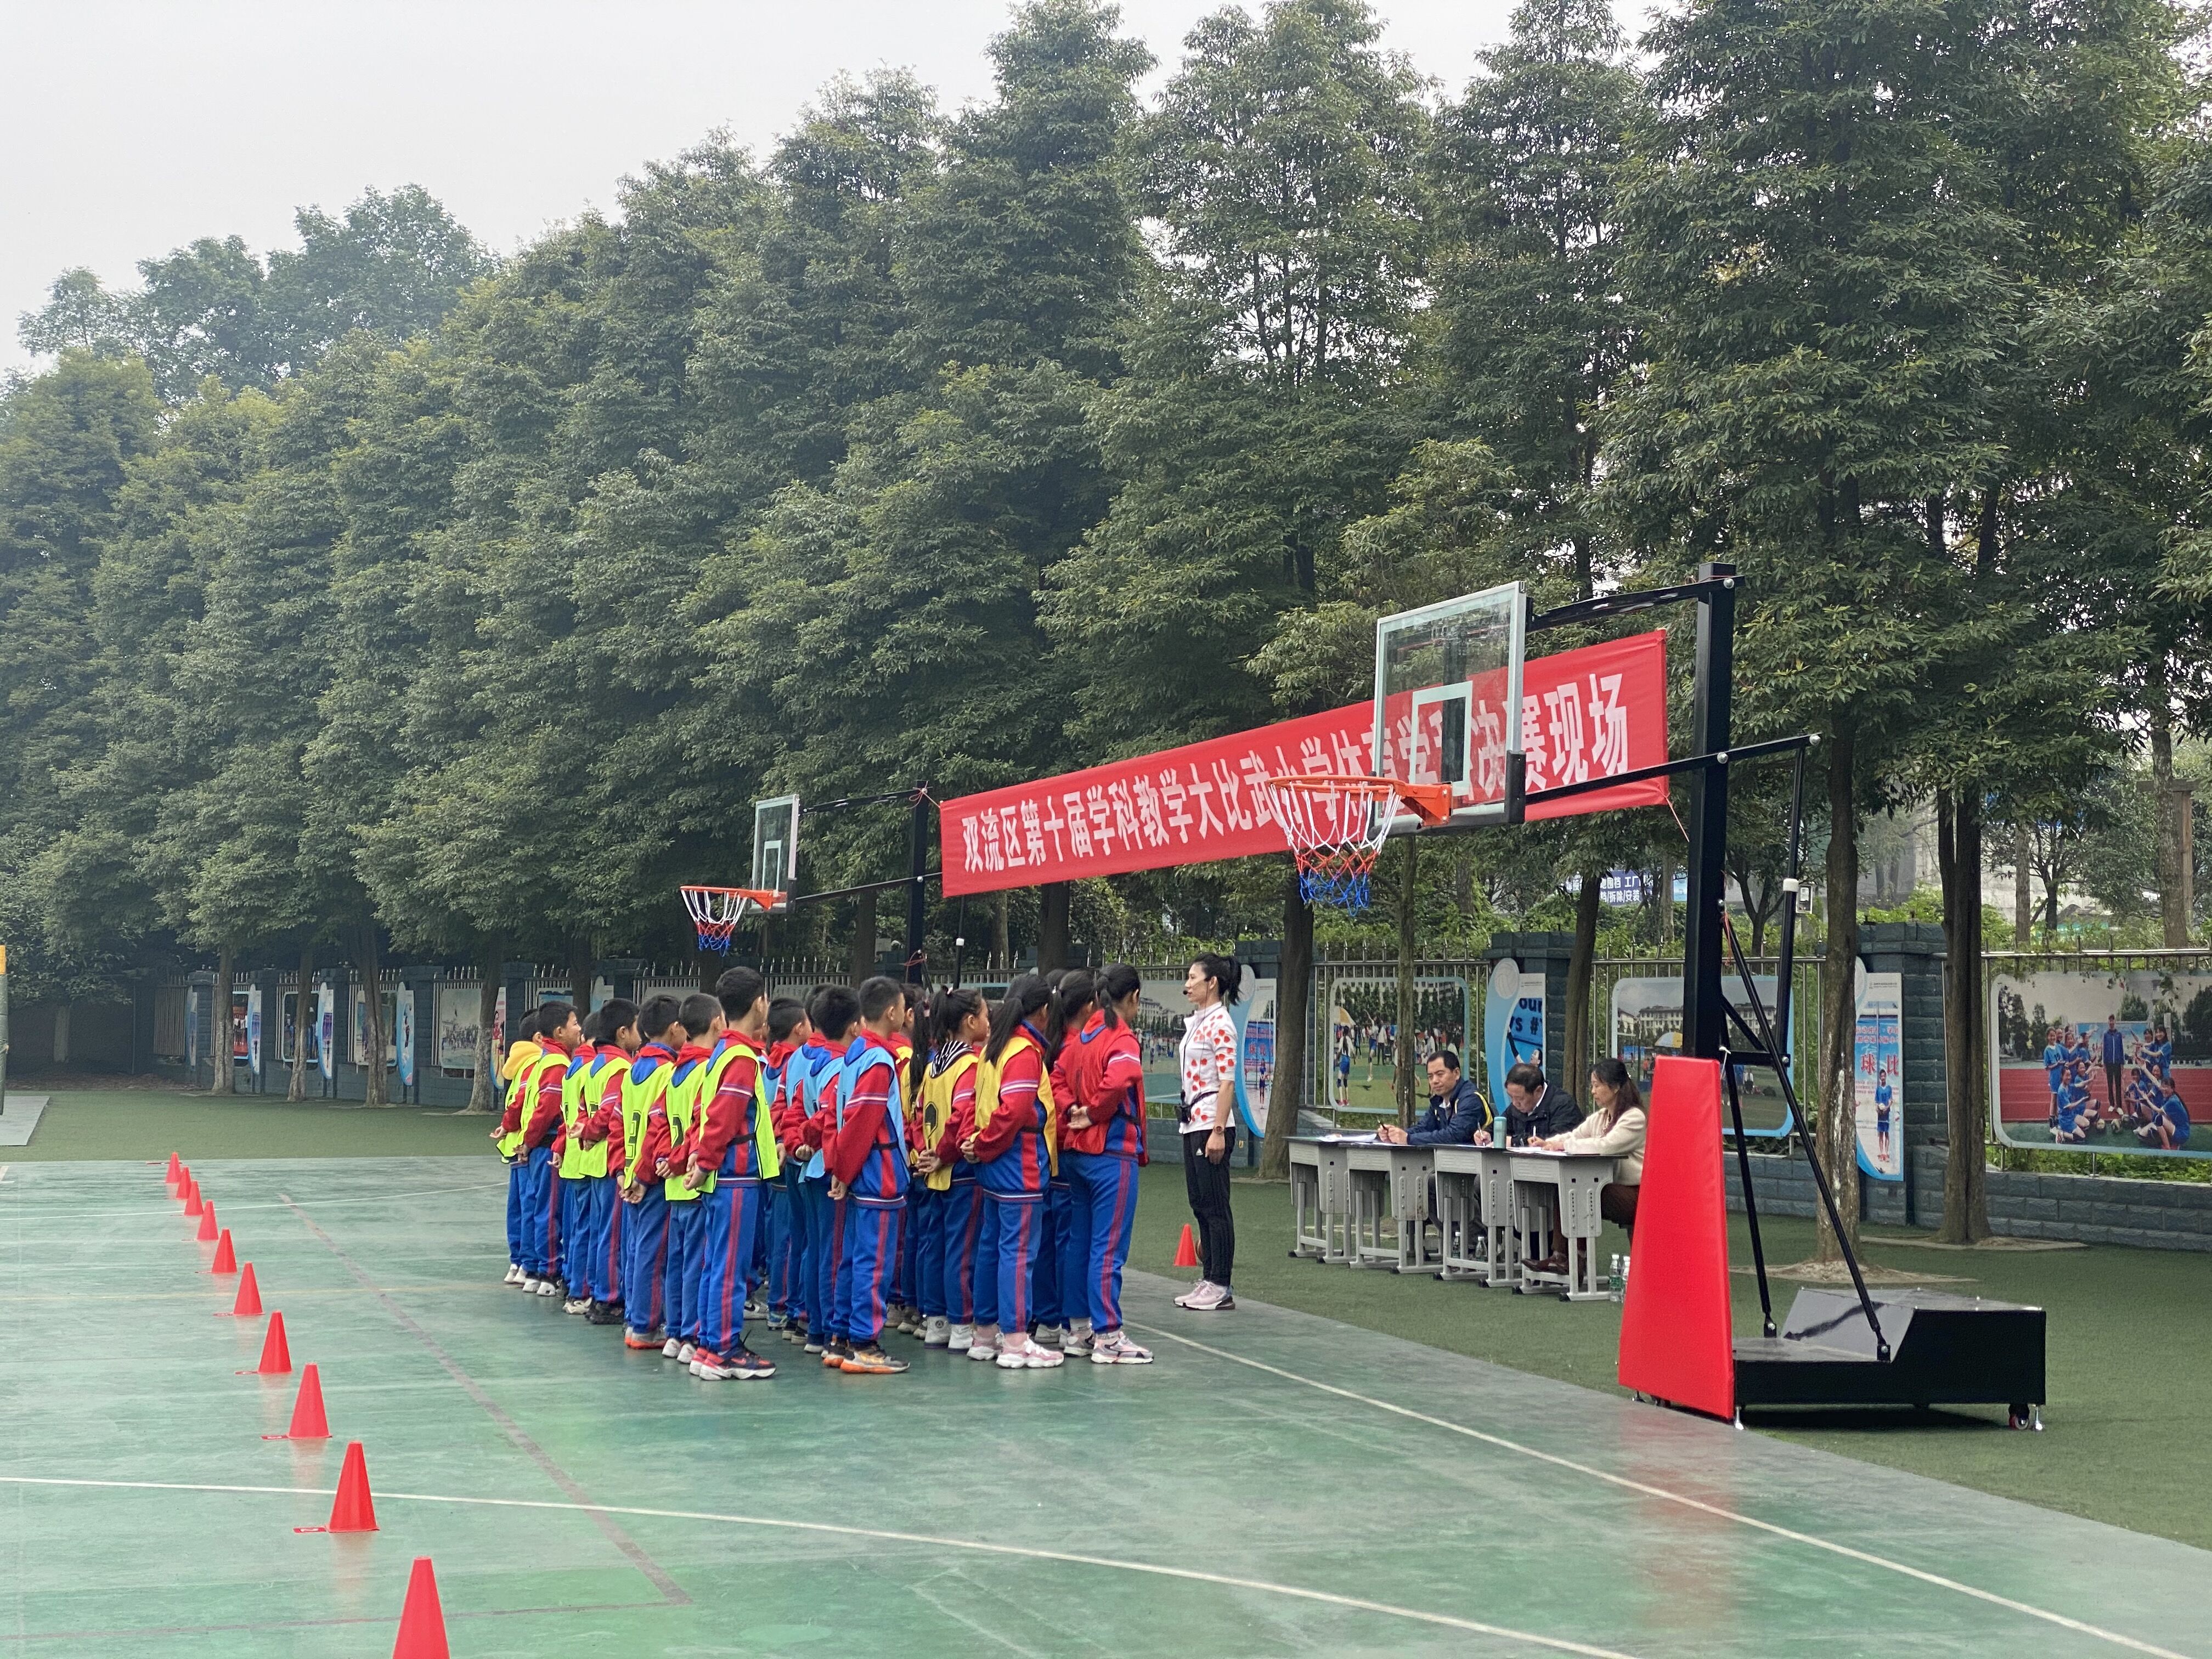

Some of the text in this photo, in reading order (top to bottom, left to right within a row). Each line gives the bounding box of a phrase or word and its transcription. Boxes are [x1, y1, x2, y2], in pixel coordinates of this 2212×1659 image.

[962, 673, 1628, 873] 双流区第十届学科教学大比武小学体育学决赛现场
